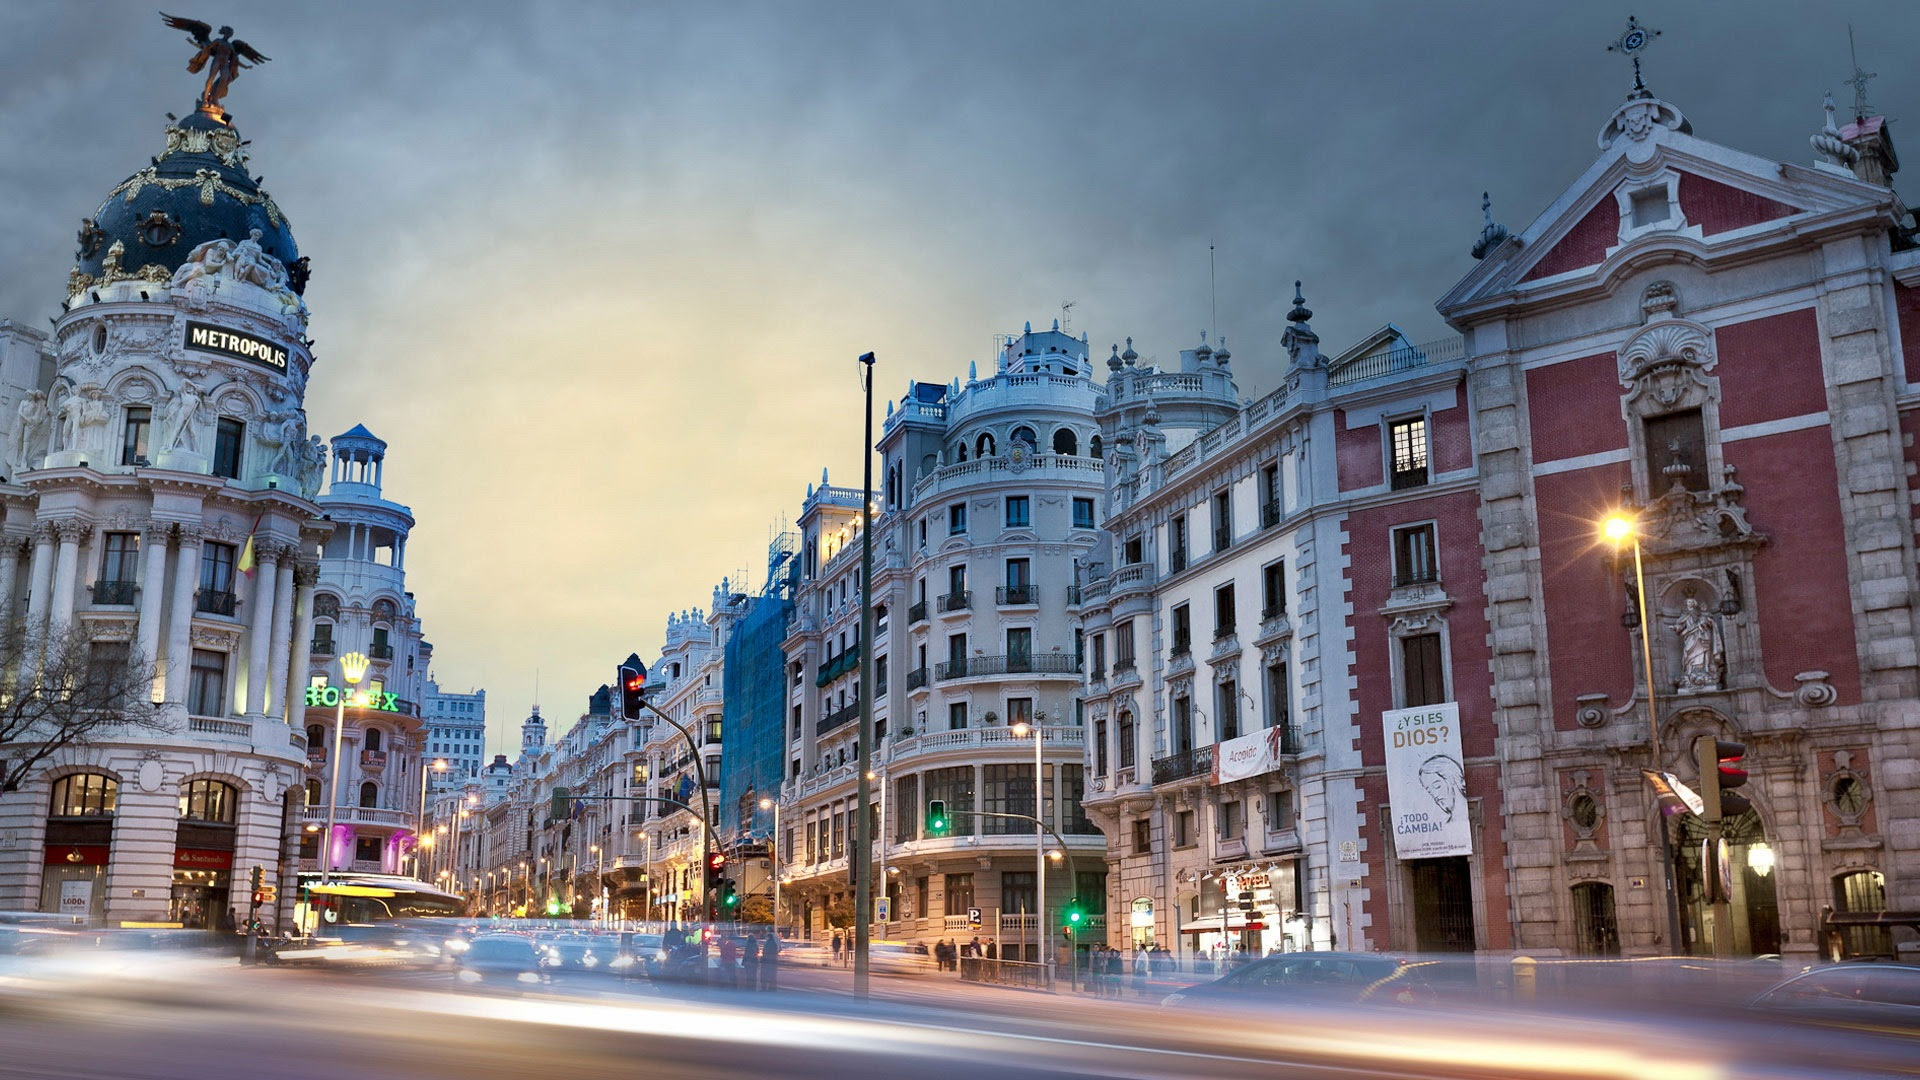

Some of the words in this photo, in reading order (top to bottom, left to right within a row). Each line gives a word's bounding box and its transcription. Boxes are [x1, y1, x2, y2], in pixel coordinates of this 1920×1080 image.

[192, 328, 286, 368] METROPOLIS
[304, 686, 399, 712] ROLEX
[1398, 717, 1411, 730] ¿Y
[1414, 714, 1425, 726] SI
[1428, 712, 1443, 724] ES
[1394, 726, 1449, 748] DIOS?
[1400, 812, 1429, 825] ¡TODO
[1397, 822, 1443, 835] CAMBIA!
[969, 909, 980, 921] P
